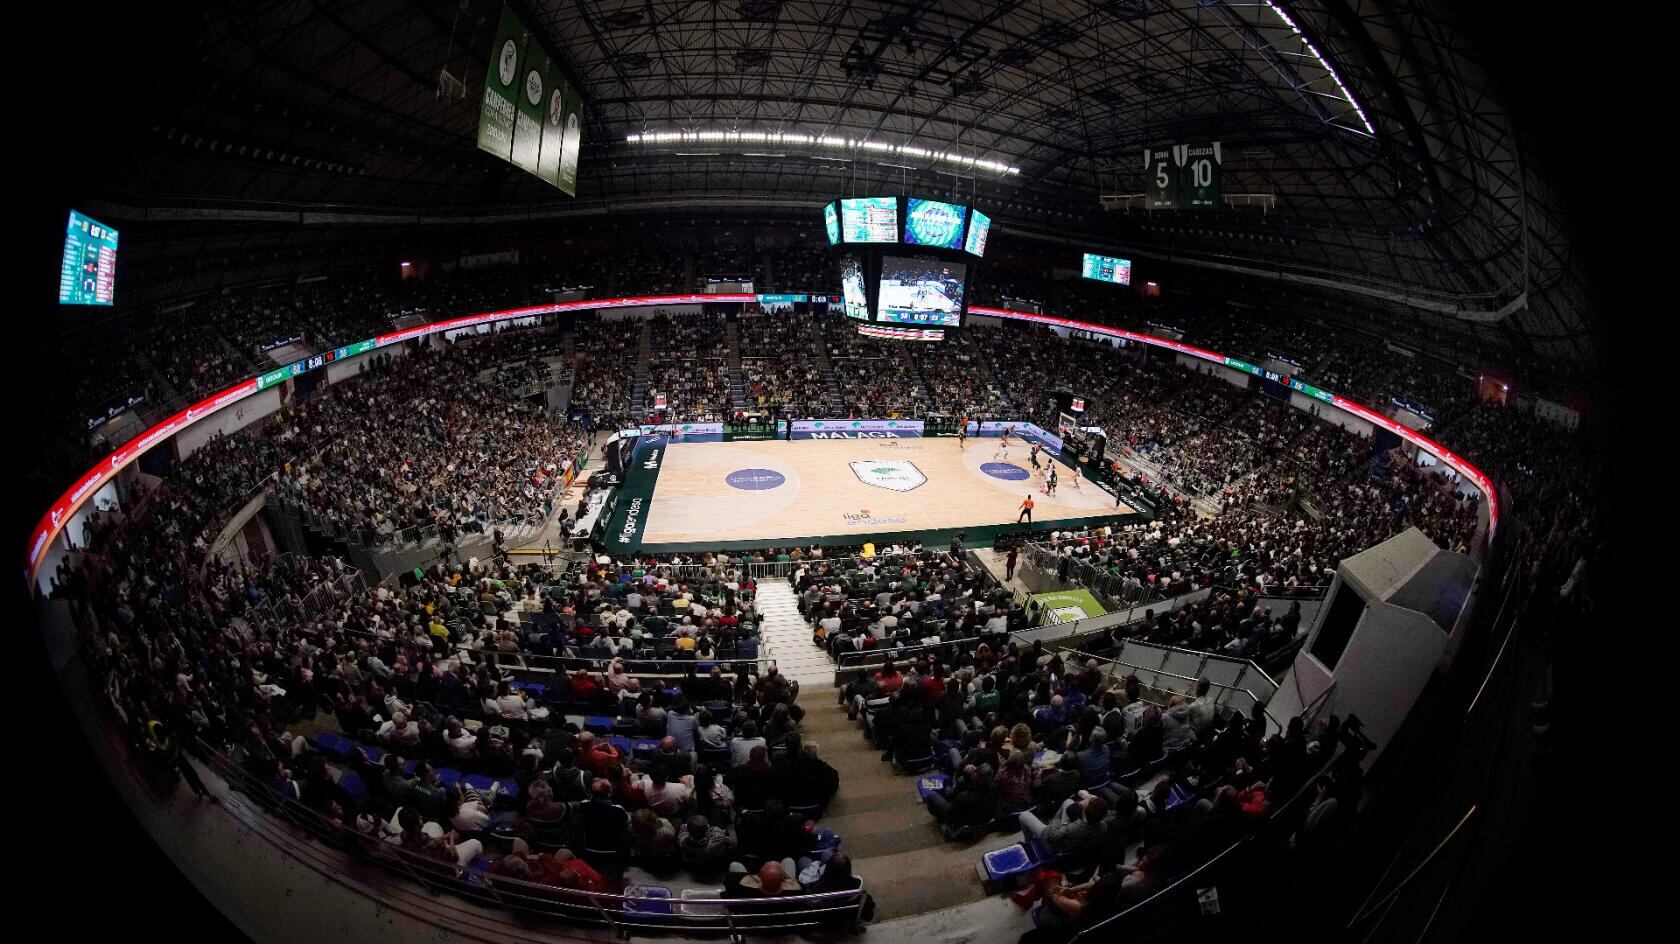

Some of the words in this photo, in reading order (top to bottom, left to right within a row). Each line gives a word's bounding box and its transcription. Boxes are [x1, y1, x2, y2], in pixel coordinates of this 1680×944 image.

[1156, 162, 1169, 188] 5
[1190, 159, 1212, 187] 10
[618, 497, 643, 544] #ligaendesa
[842, 512, 871, 520] liga
[847, 517, 907, 526] endesa
